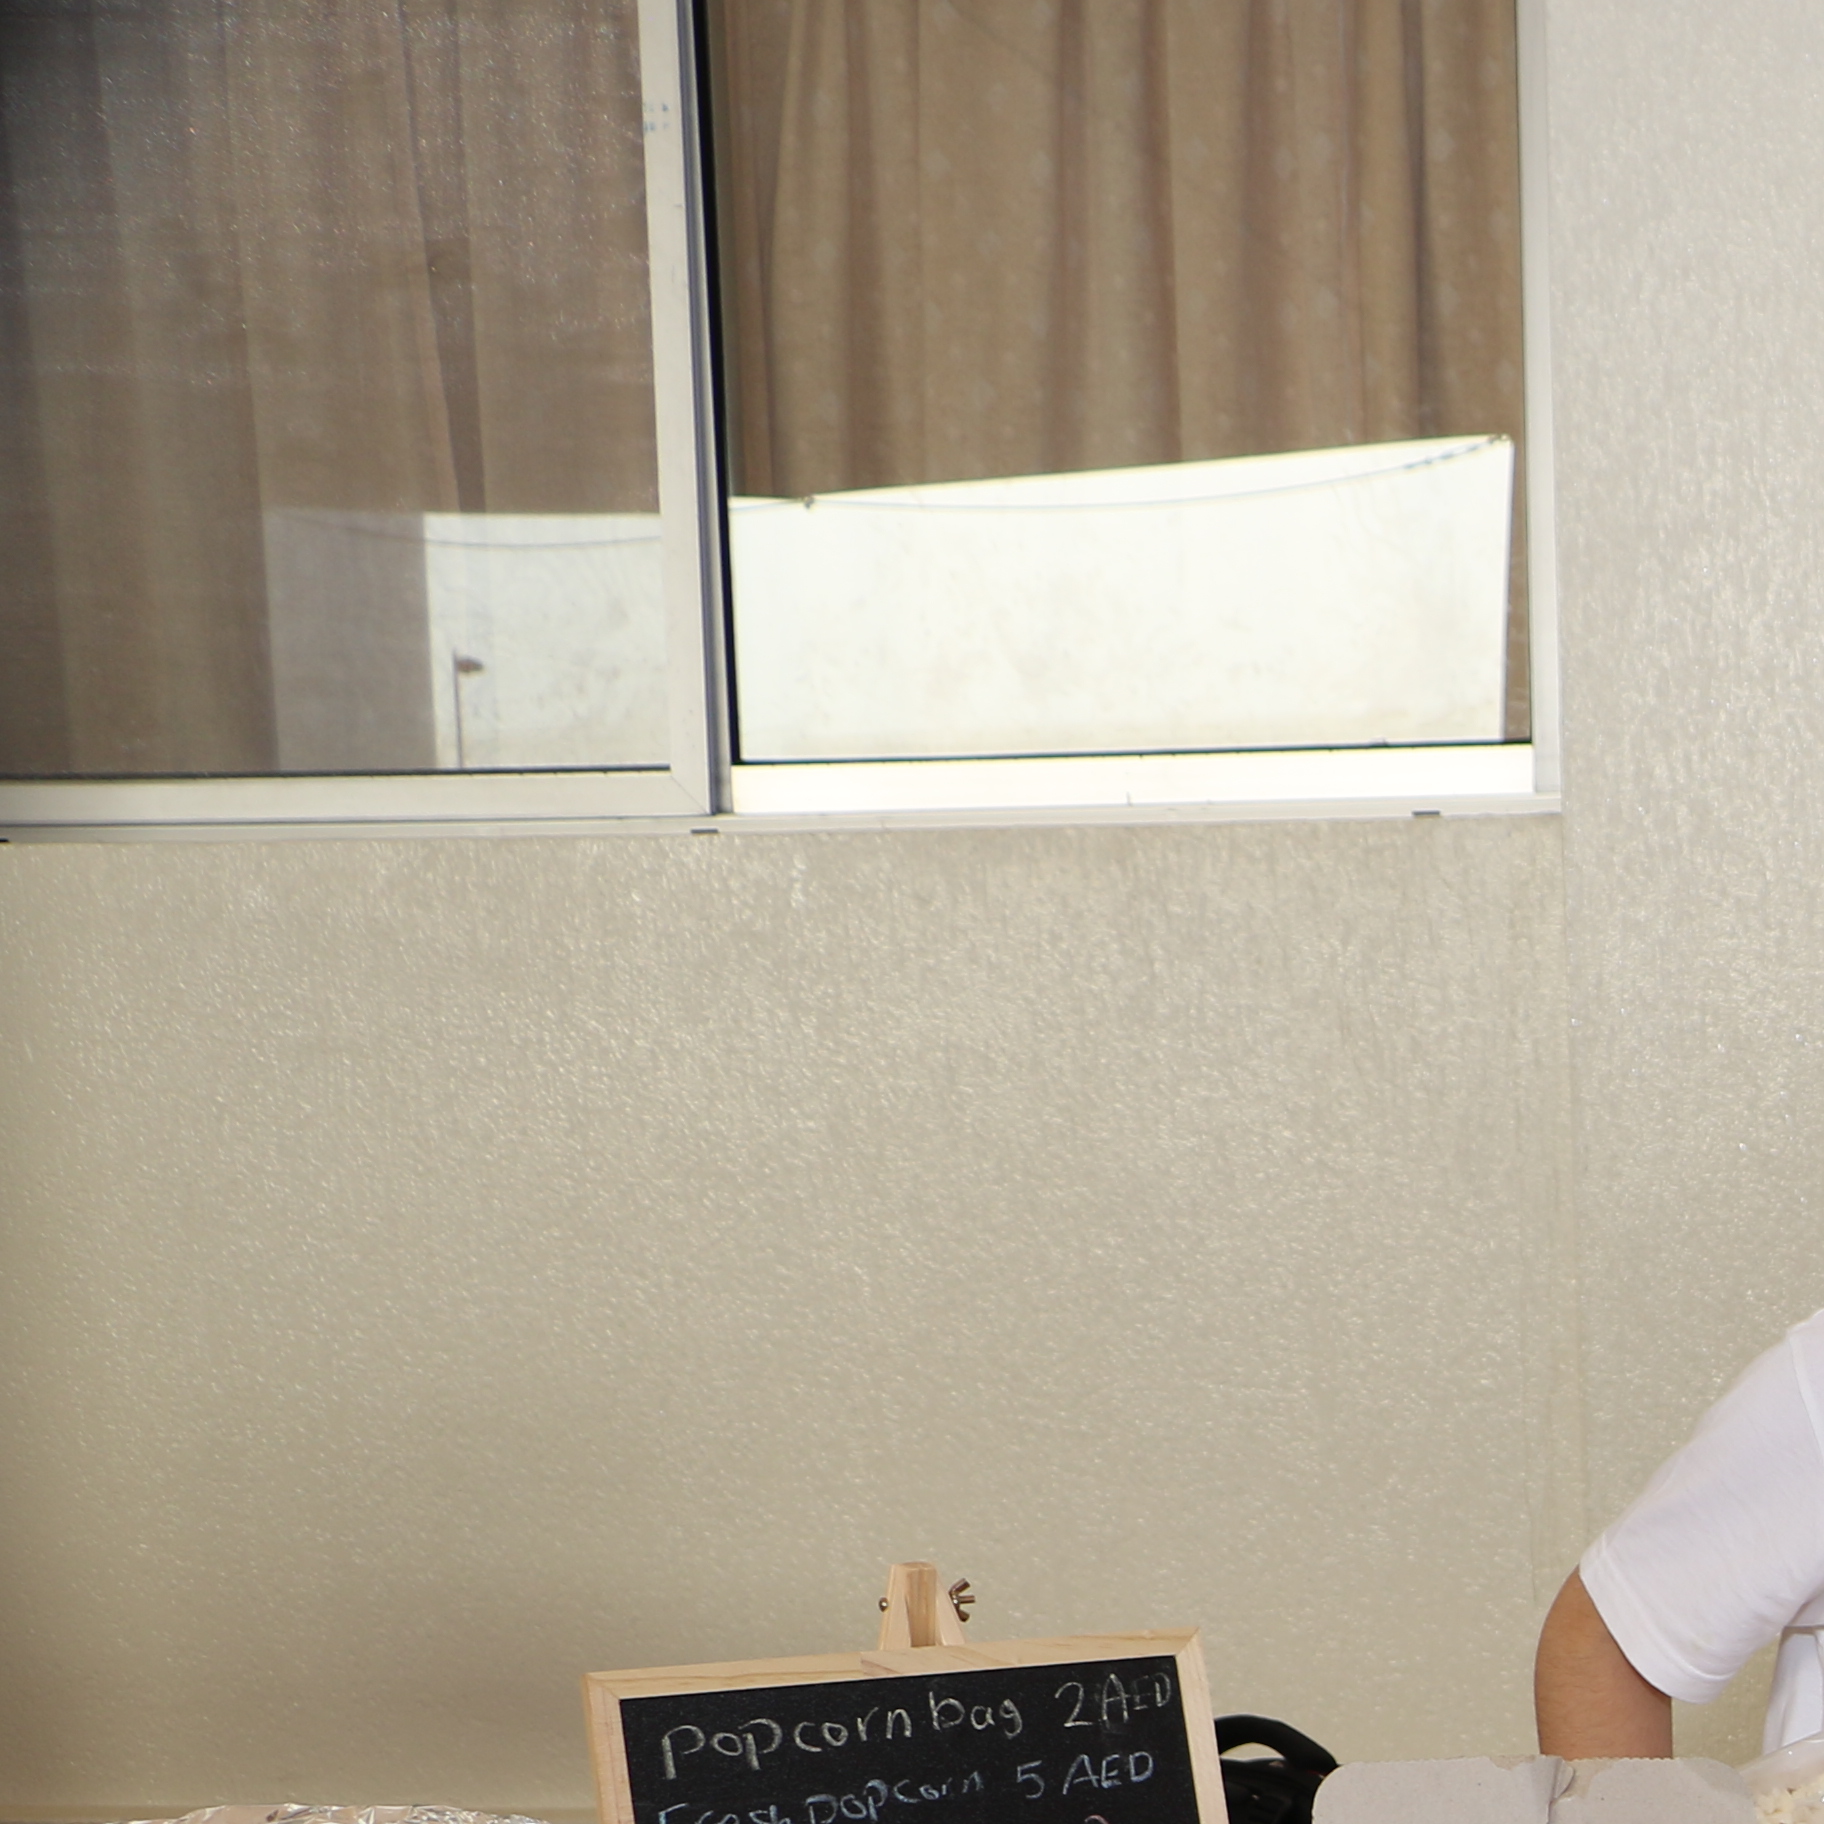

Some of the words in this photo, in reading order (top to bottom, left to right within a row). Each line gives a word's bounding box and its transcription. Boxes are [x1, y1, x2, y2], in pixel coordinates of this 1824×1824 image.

[929, 1691, 1023, 1740] bag
[1053, 1681, 1094, 1729] 2
[1099, 1671, 1172, 1725] AED
[1015, 1760, 1044, 1800] 5
[1061, 1750, 1155, 1796] AED
